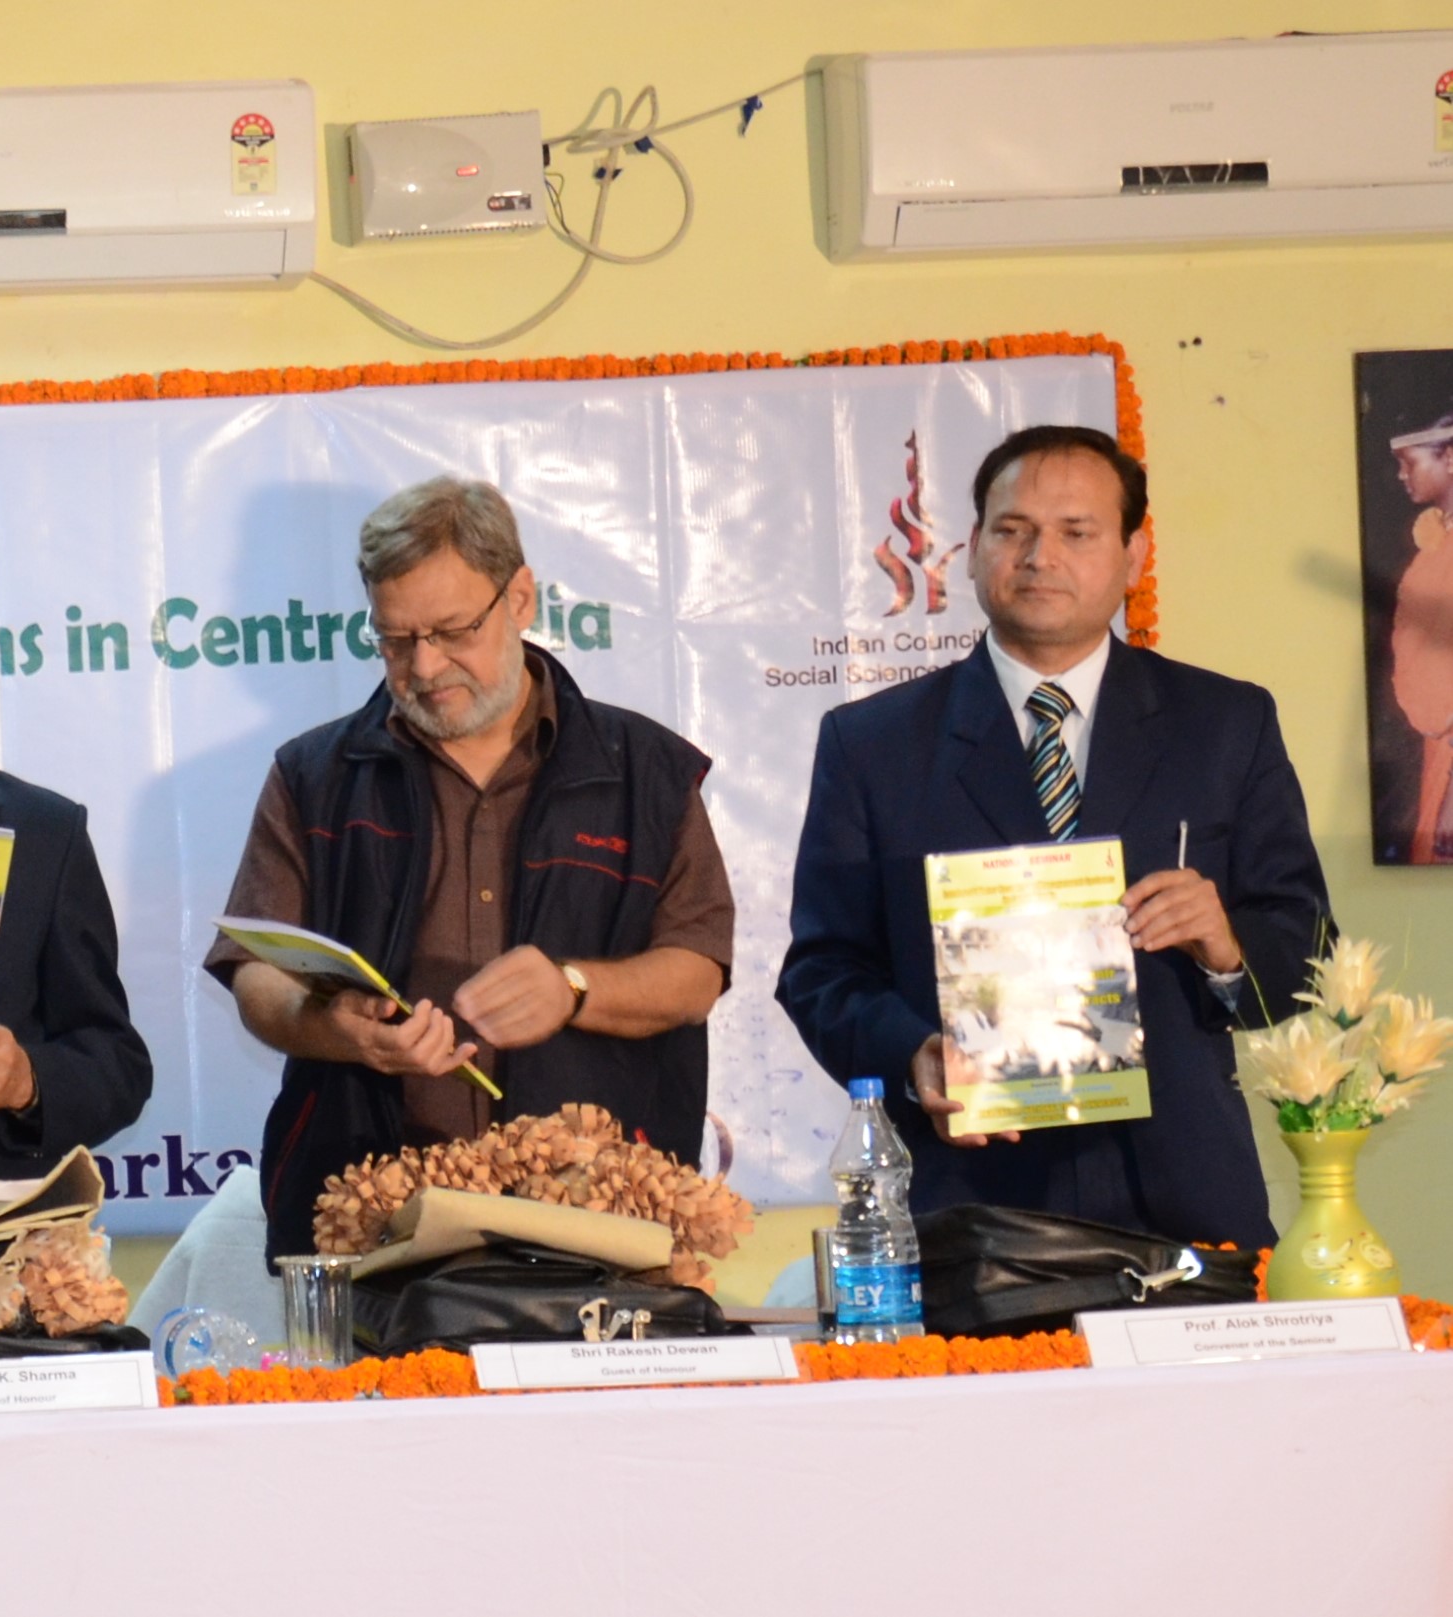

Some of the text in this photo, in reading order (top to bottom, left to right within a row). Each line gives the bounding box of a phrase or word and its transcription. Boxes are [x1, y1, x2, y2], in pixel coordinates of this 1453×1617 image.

[66, 605, 130, 673] in
[151, 596, 382, 671] Centra
[765, 665, 837, 687] Social
[1184, 1314, 1334, 1332] Prof. Alok Shrotriya
[571, 1343, 718, 1359] Shri Rakesh Dewan
[1194, 1336, 1336, 1352] Convener of the Seminar
[18, 1370, 77, 1382] Sharma
[601, 1365, 697, 1376] Guest of Honour
[0, 1395, 11, 1405] of
[14, 1394, 57, 1404] Honour
